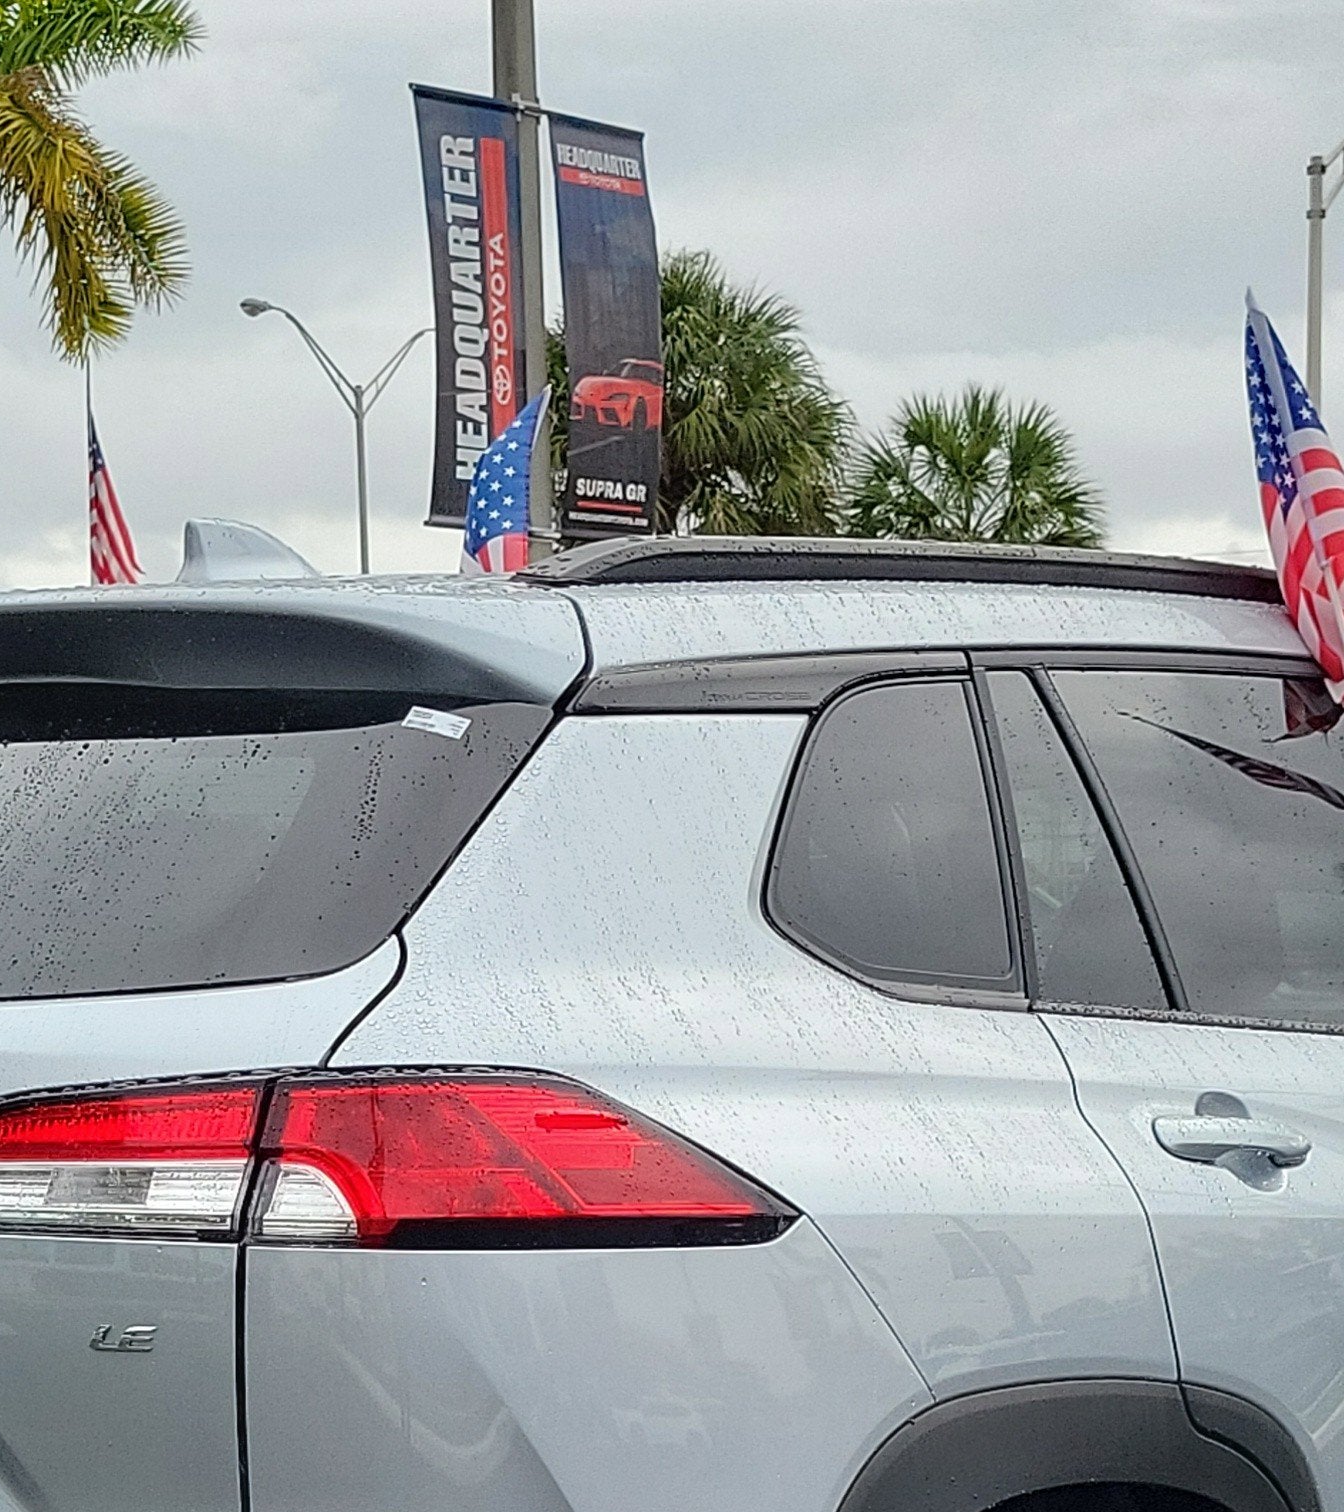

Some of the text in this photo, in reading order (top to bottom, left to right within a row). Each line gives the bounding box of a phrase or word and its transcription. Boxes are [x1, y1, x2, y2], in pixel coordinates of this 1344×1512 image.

[556, 143, 641, 180] HEADQUARTER
[440, 134, 489, 480] HEADQUARTER
[487, 233, 511, 362] TOYOTA
[576, 478, 647, 502] SUPRA GR
[89, 1324, 158, 1352] LE
